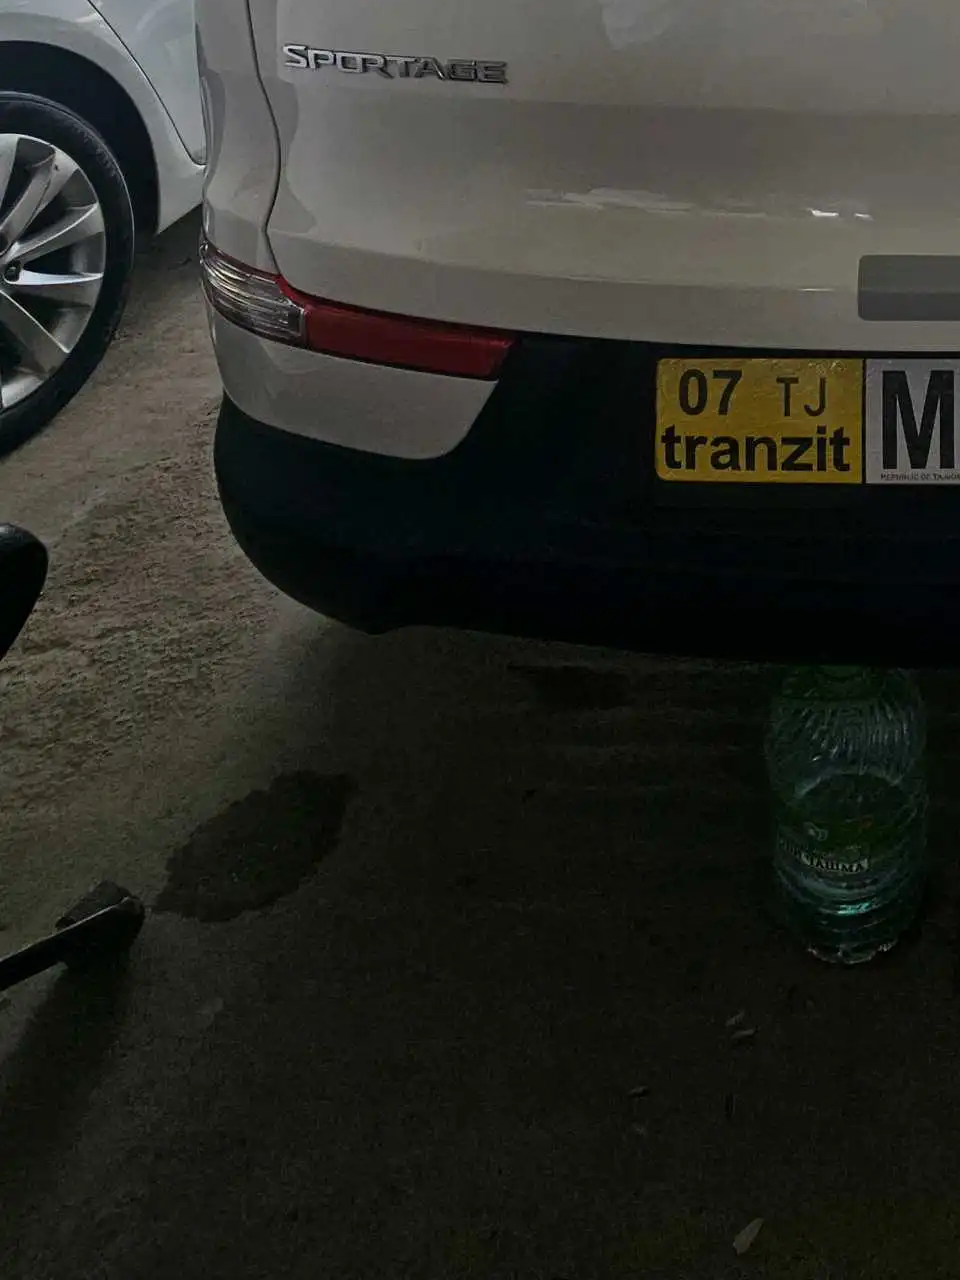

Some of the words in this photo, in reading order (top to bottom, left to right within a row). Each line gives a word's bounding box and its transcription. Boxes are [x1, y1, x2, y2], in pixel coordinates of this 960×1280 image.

[282, 43, 510, 85] SPORTAGE
[678, 368, 743, 418] 07
[776, 375, 828, 418] TJ
[660, 423, 851, 474] tranzit
